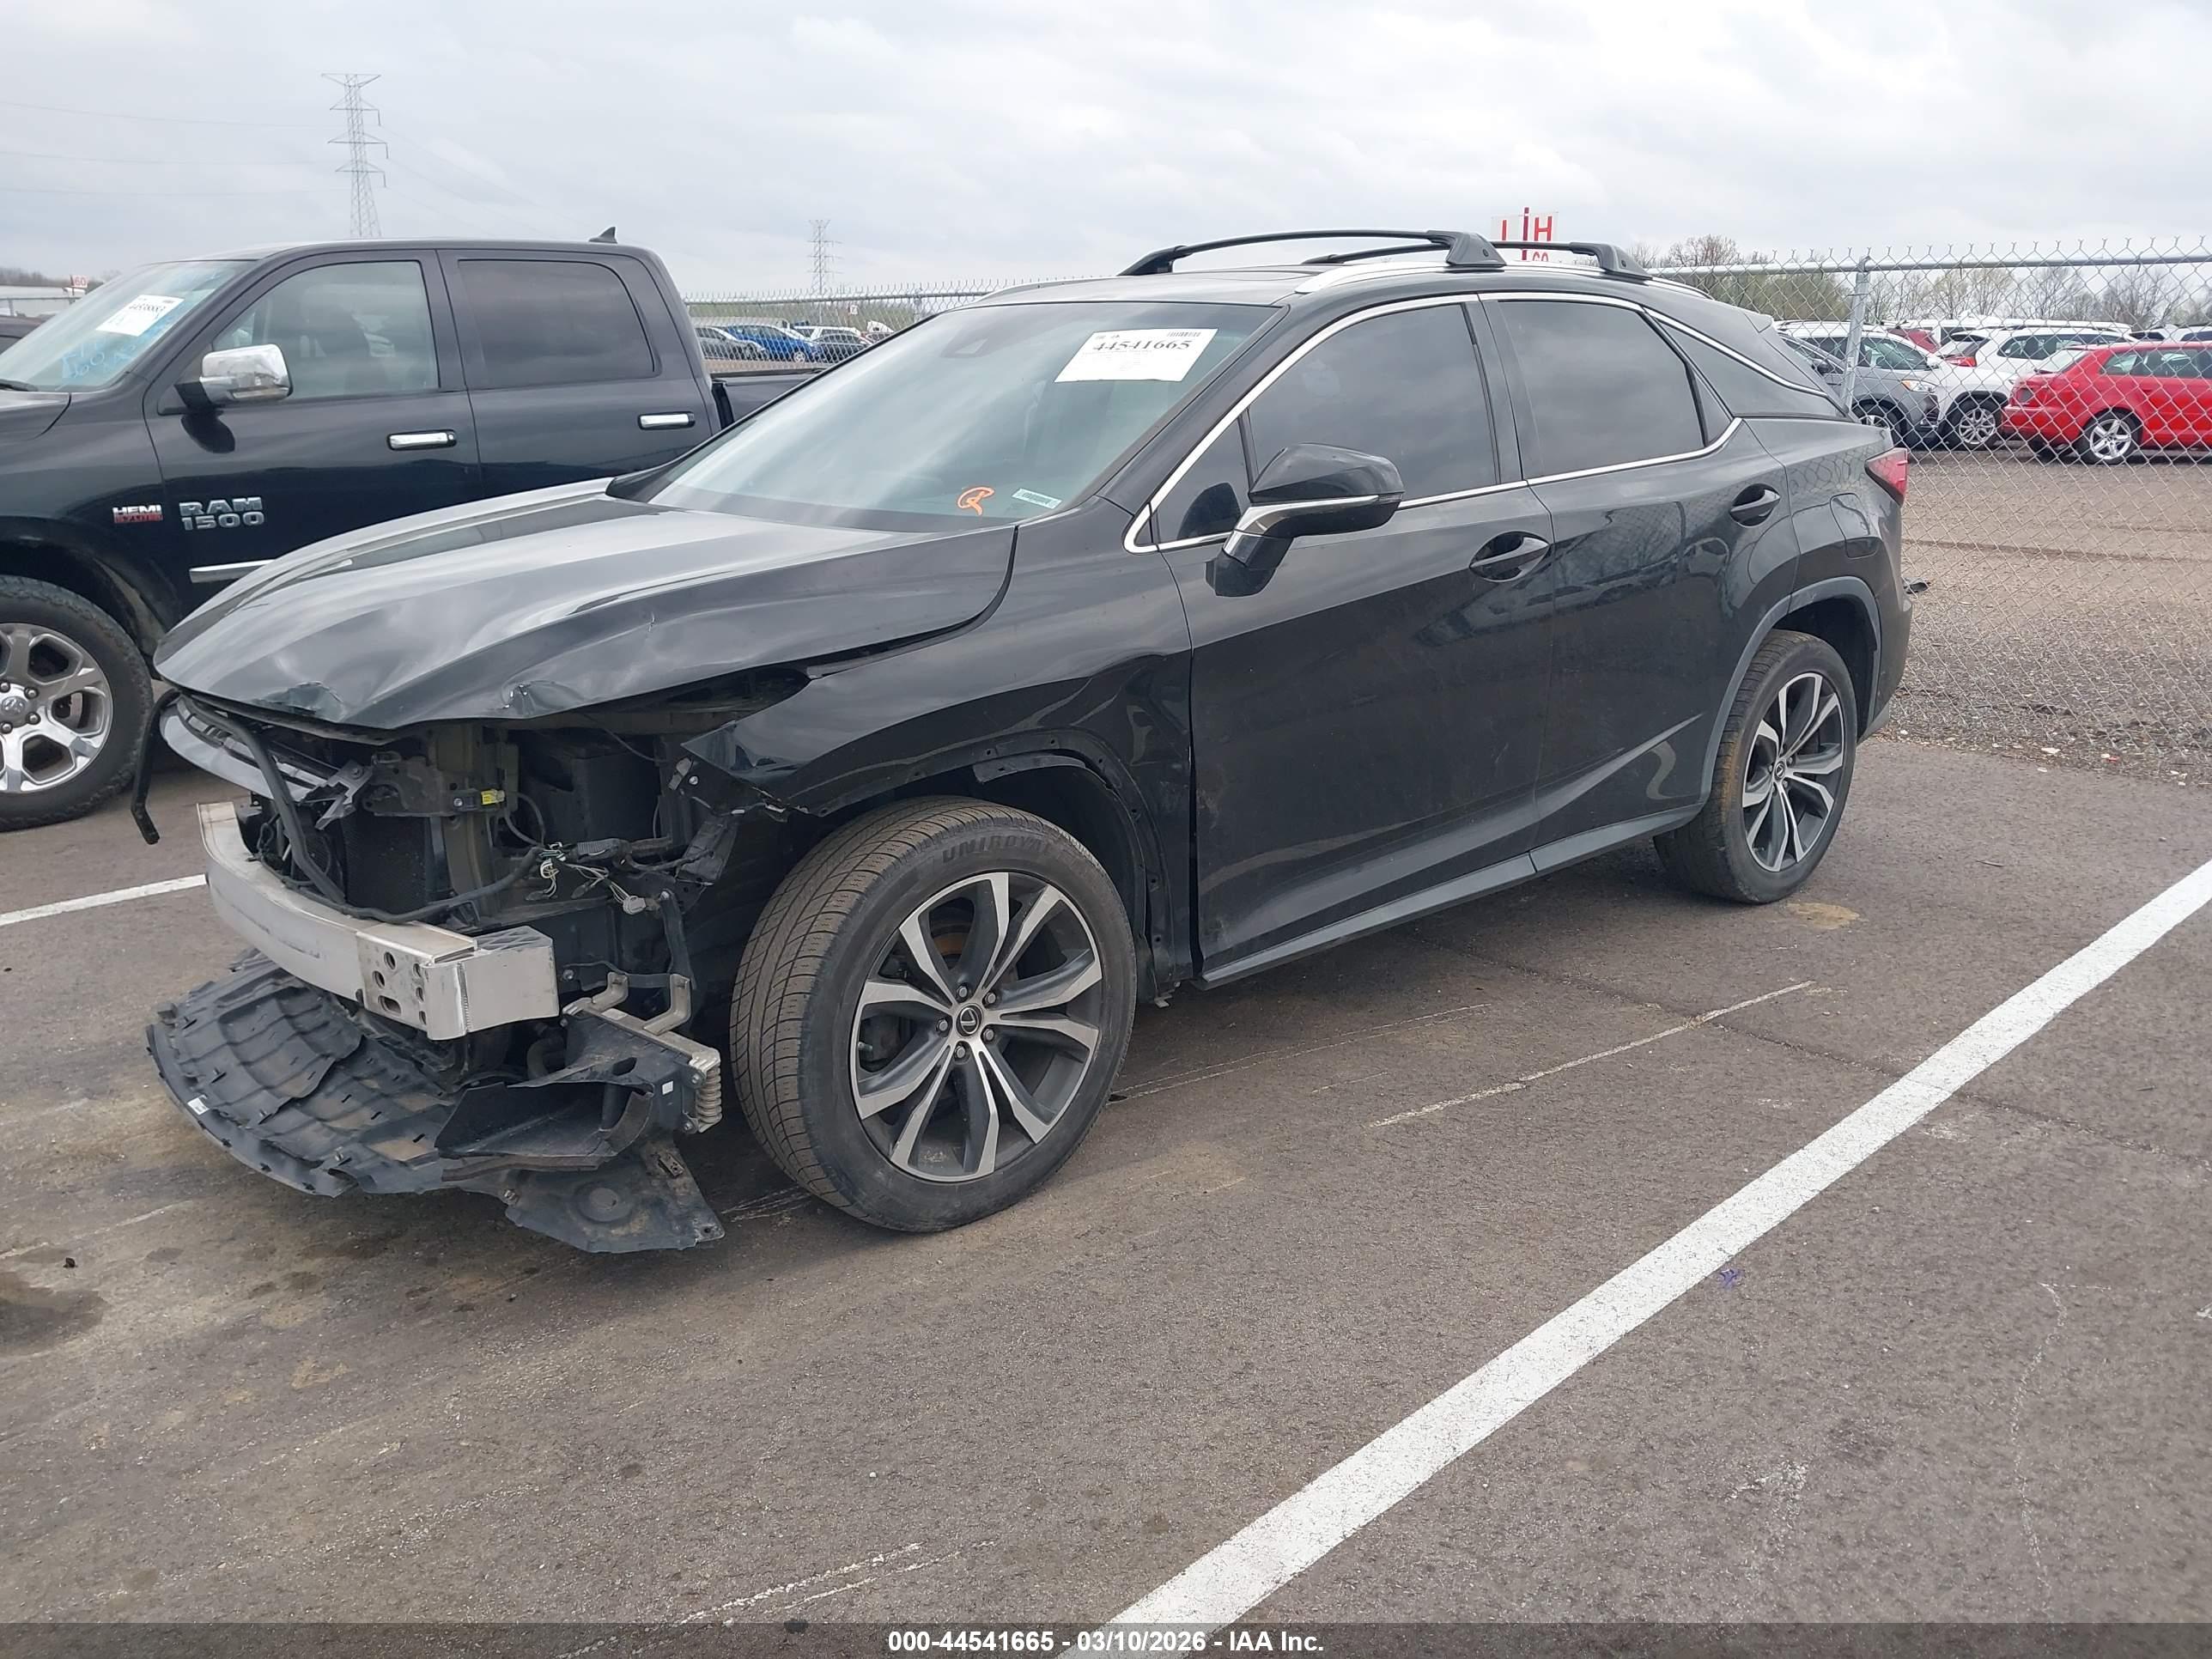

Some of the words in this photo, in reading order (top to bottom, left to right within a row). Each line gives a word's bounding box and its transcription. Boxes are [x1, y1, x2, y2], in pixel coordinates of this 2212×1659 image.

[1092, 340, 1193, 351] 44541665
[112, 504, 162, 514] HEMI
[179, 496, 263, 516] RAM
[181, 511, 264, 531] 1500
